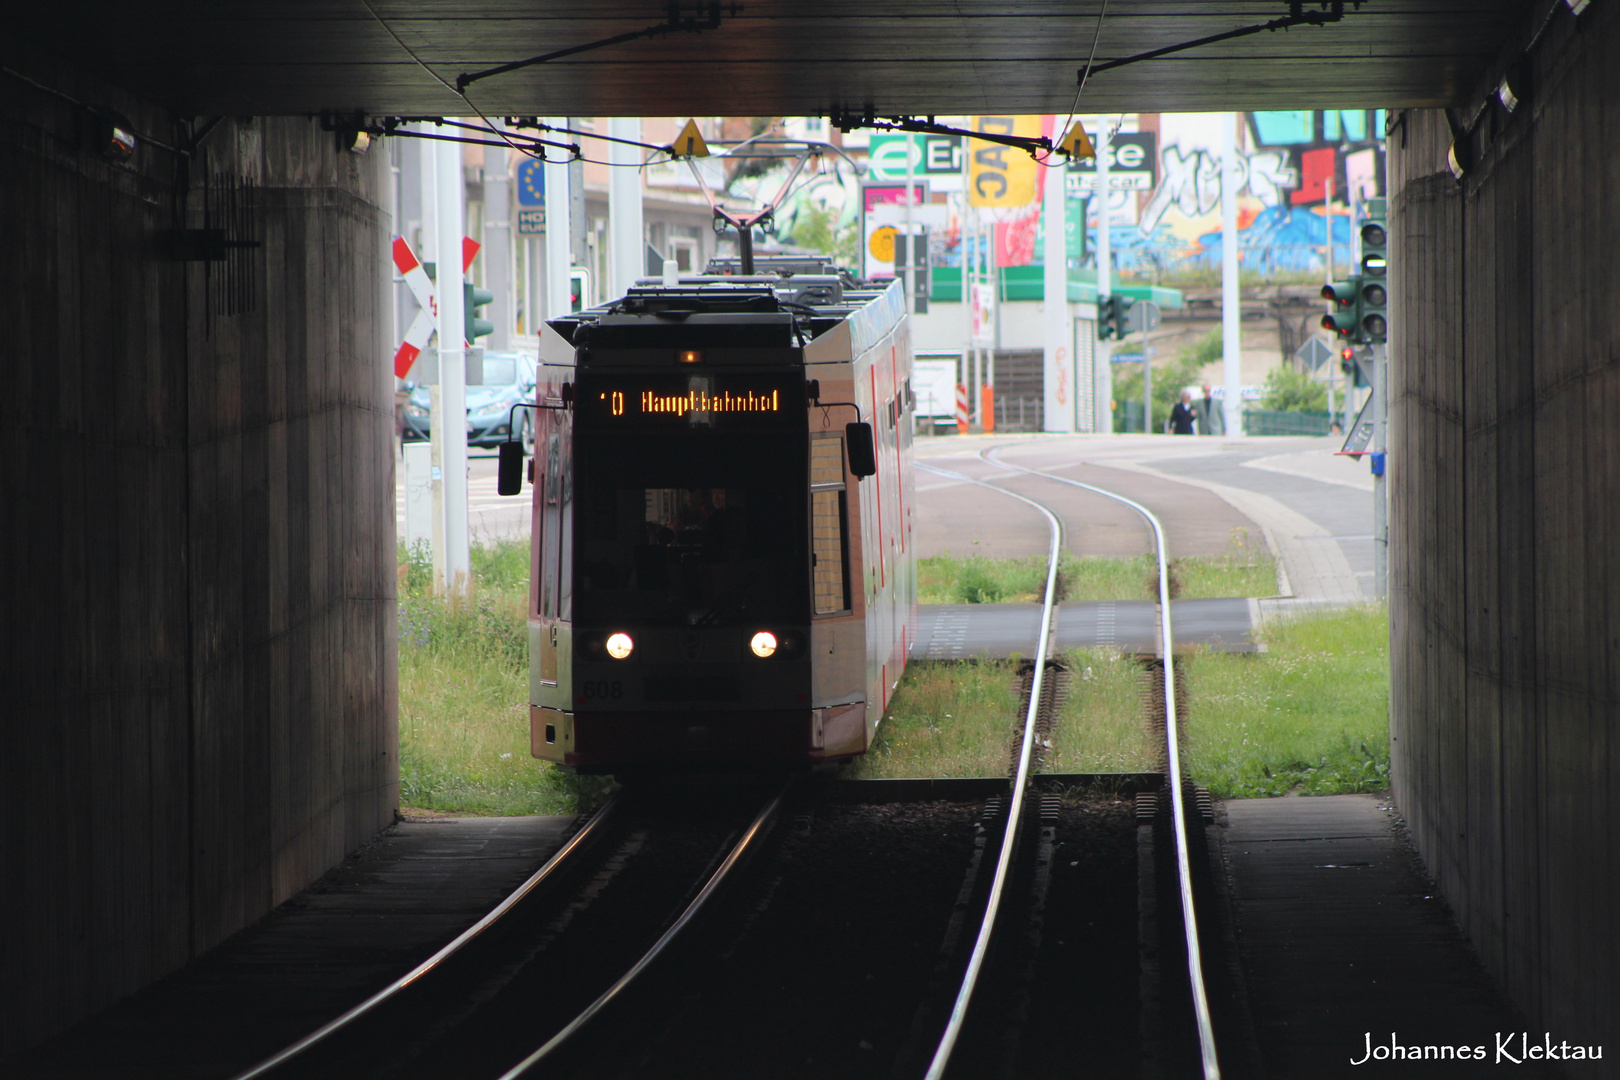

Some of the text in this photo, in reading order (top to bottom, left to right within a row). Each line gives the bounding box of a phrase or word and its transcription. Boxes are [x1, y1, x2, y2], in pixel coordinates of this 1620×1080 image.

[520, 223, 546, 232] EUR
[642, 389, 779, 417] Hauptbahnhof
[583, 680, 623, 699] 608
